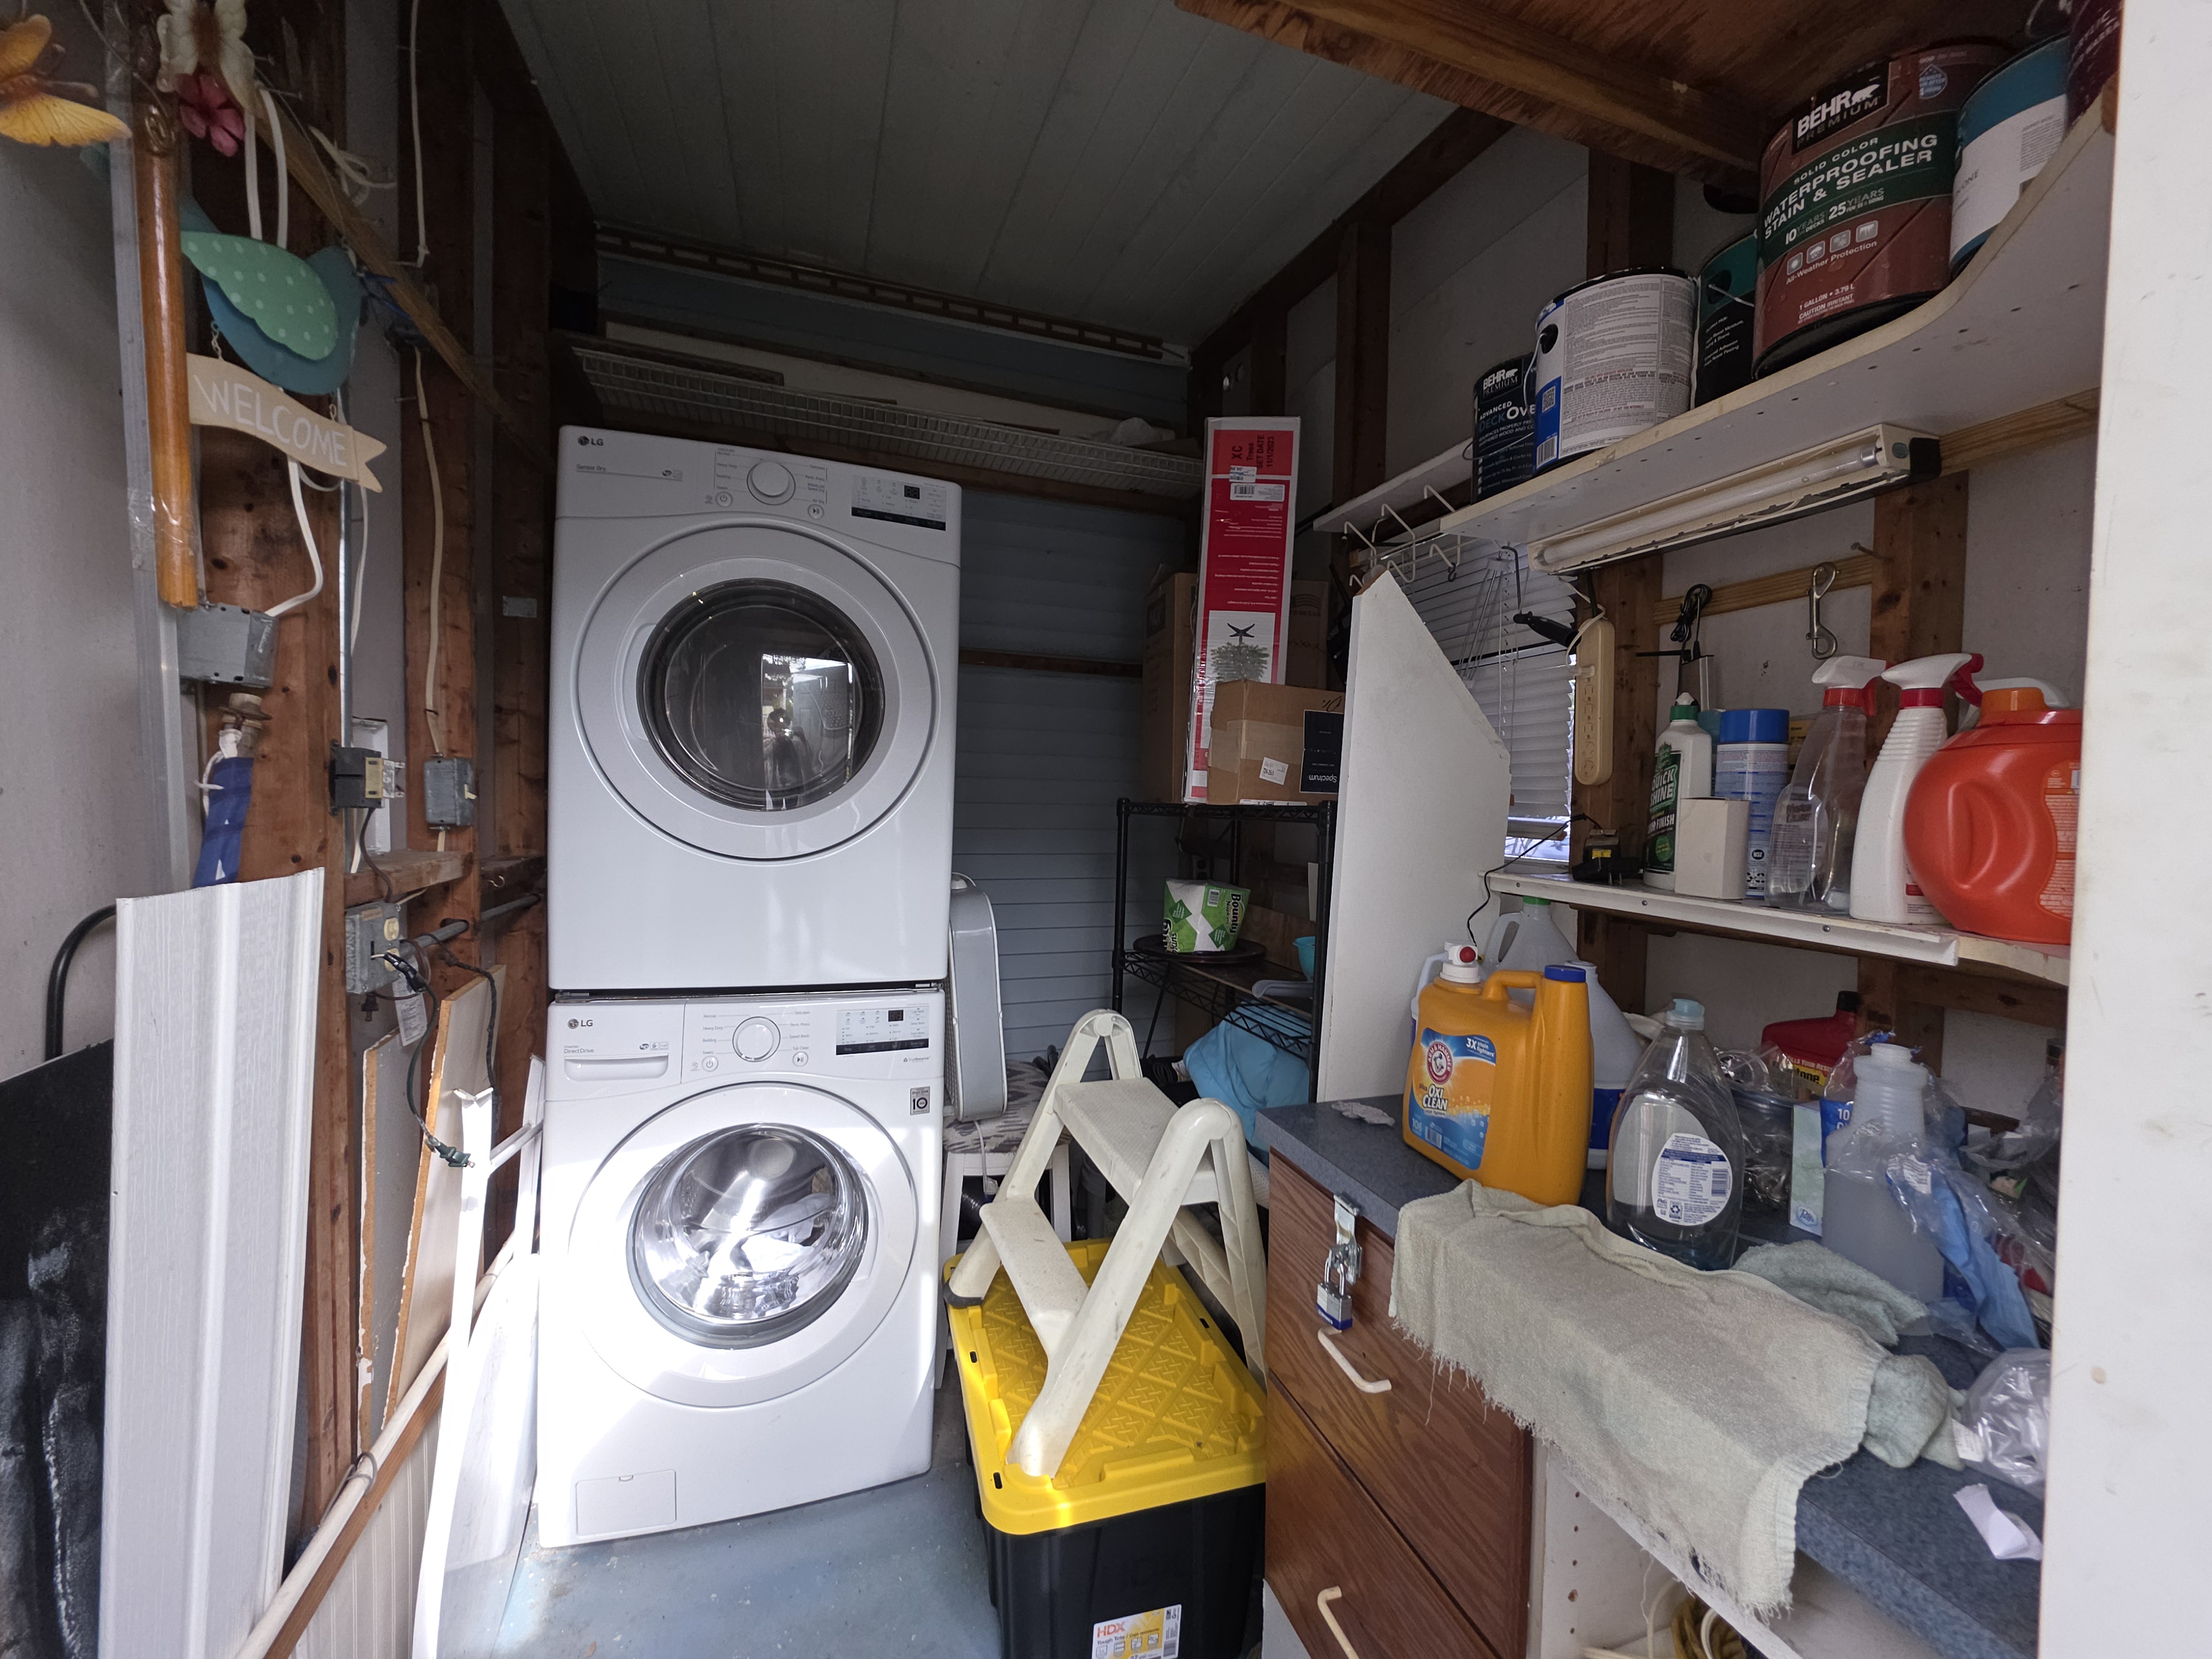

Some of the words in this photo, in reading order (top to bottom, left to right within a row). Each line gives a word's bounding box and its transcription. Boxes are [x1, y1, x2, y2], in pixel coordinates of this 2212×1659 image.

[1797, 90, 1853, 139] BEHR
[1797, 97, 1879, 148] PREMIUM
[1793, 160, 1827, 185] SOLID
[1831, 137, 1879, 162] COLOR
[1764, 134, 1938, 227] WATERPROOFING
[1765, 198, 1805, 239] STAIN
[1812, 188, 1827, 202] &
[1835, 149, 1933, 191] SEALER
[1785, 228, 1797, 245] 10
[1797, 211, 1825, 231] YEARS
[1828, 201, 1846, 220] 25
[1806, 218, 1825, 233] DECKS
[1786, 259, 1828, 285] All-Weather
[1830, 241, 1877, 263] Protection
[1798, 302, 1826, 320] CAUTION
[1827, 293, 1854, 309] IRRITANT
[1804, 293, 1828, 309] GALLON
[1834, 285, 1849, 295] 3.79
[1483, 368, 1506, 390] BEHR
[1483, 375, 1518, 398] PREMIUM
[193, 374, 348, 467] WELCOME
[1479, 400, 1512, 421] ADVANCED
[1479, 412, 1505, 433] DECK
[1506, 404, 1536, 420] OVE
[1499, 421, 1522, 431] PROPERLY
[1499, 429, 1514, 437] WOOD
[591, 437, 604, 446] LG
[1231, 445, 1243, 460] XC
[1246, 441, 1255, 461] Trees
[1308, 773, 1337, 783] Spectrum
[1651, 768, 1674, 791] QUICK
[1651, 782, 1674, 806] SHINE
[1656, 813, 1675, 830] FINISH
[1229, 893, 1241, 933] Bounty
[1466, 1037, 1477, 1050] 3X
[1438, 1044, 1451, 1072] HAMMER
[1422, 1093, 1448, 1111] CLEAN
[1428, 1084, 1444, 1098] OXI
[912, 1097, 928, 1110] 10
[1838, 1108, 1850, 1121] 10
[1097, 1621, 1125, 1638] HDX
